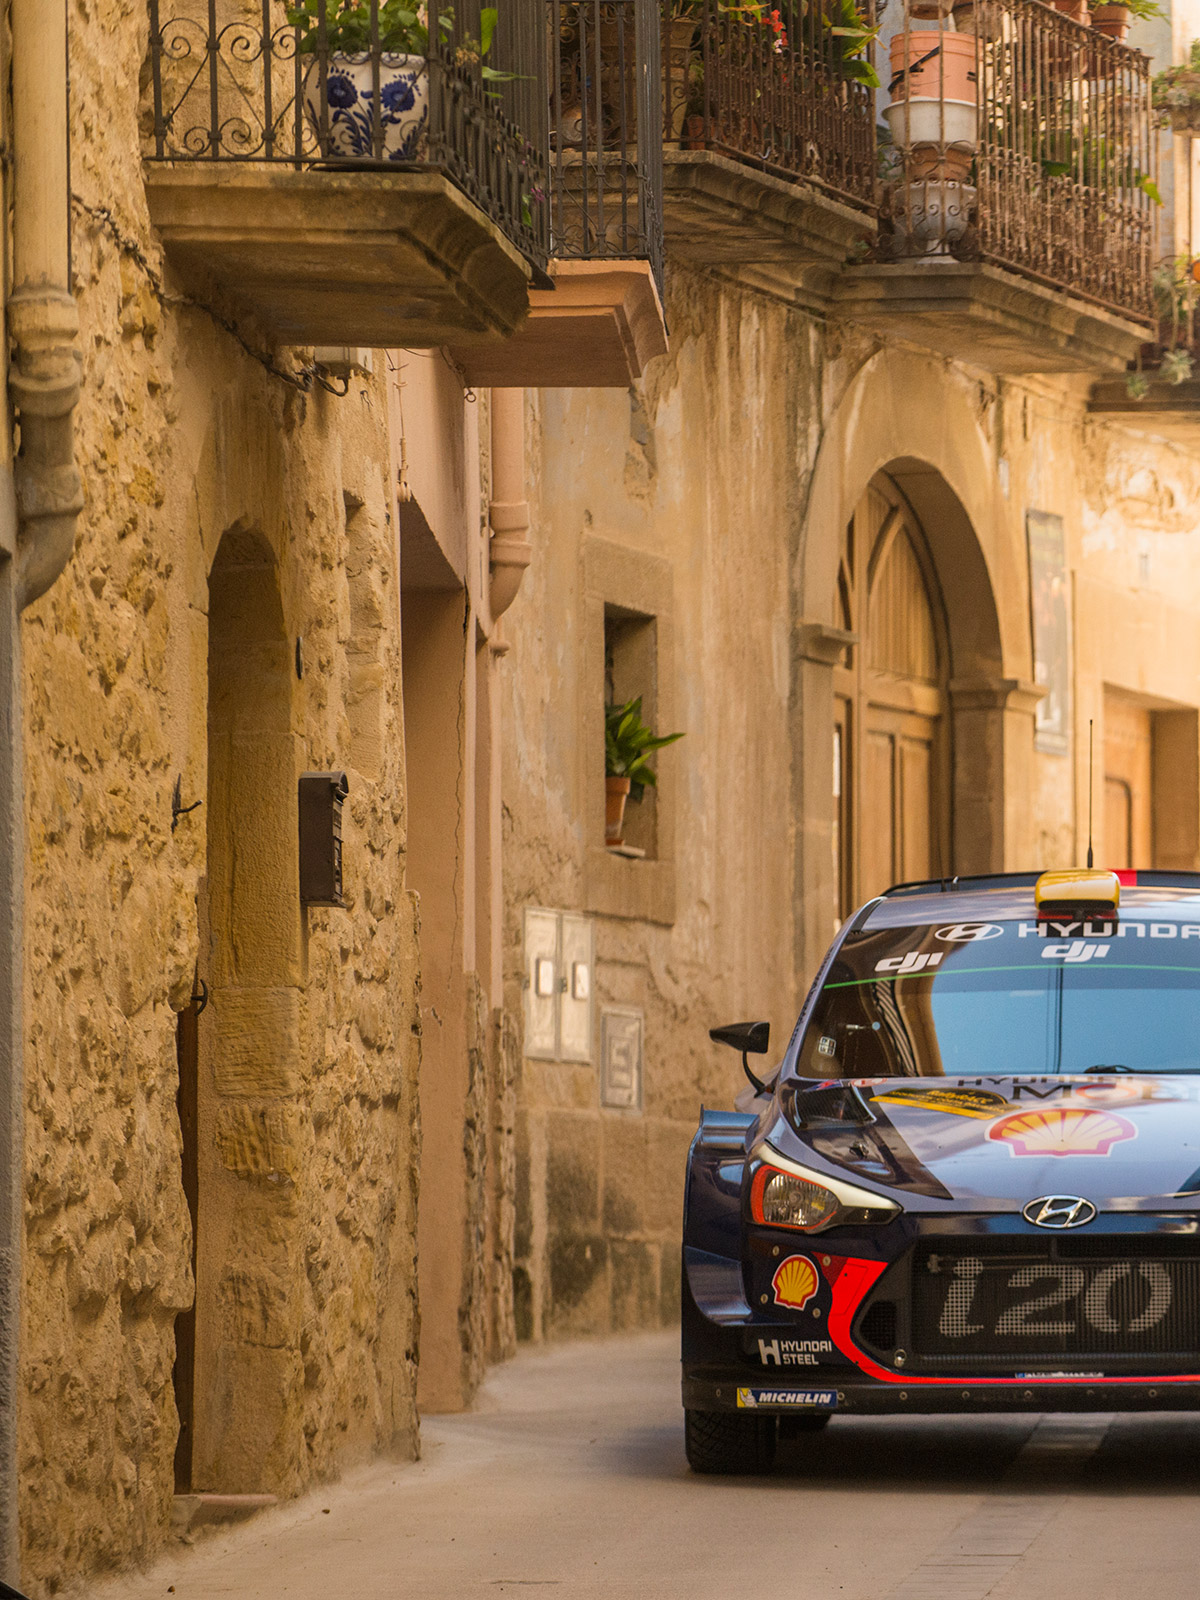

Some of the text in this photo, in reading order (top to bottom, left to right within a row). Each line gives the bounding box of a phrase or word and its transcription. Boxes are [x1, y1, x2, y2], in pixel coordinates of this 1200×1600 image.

[939, 1257, 1172, 1338] i20
[781, 1340, 833, 1353] HYUNDAI
[783, 1353, 820, 1366] STEEL
[758, 1392, 832, 1404] MICHELIN
